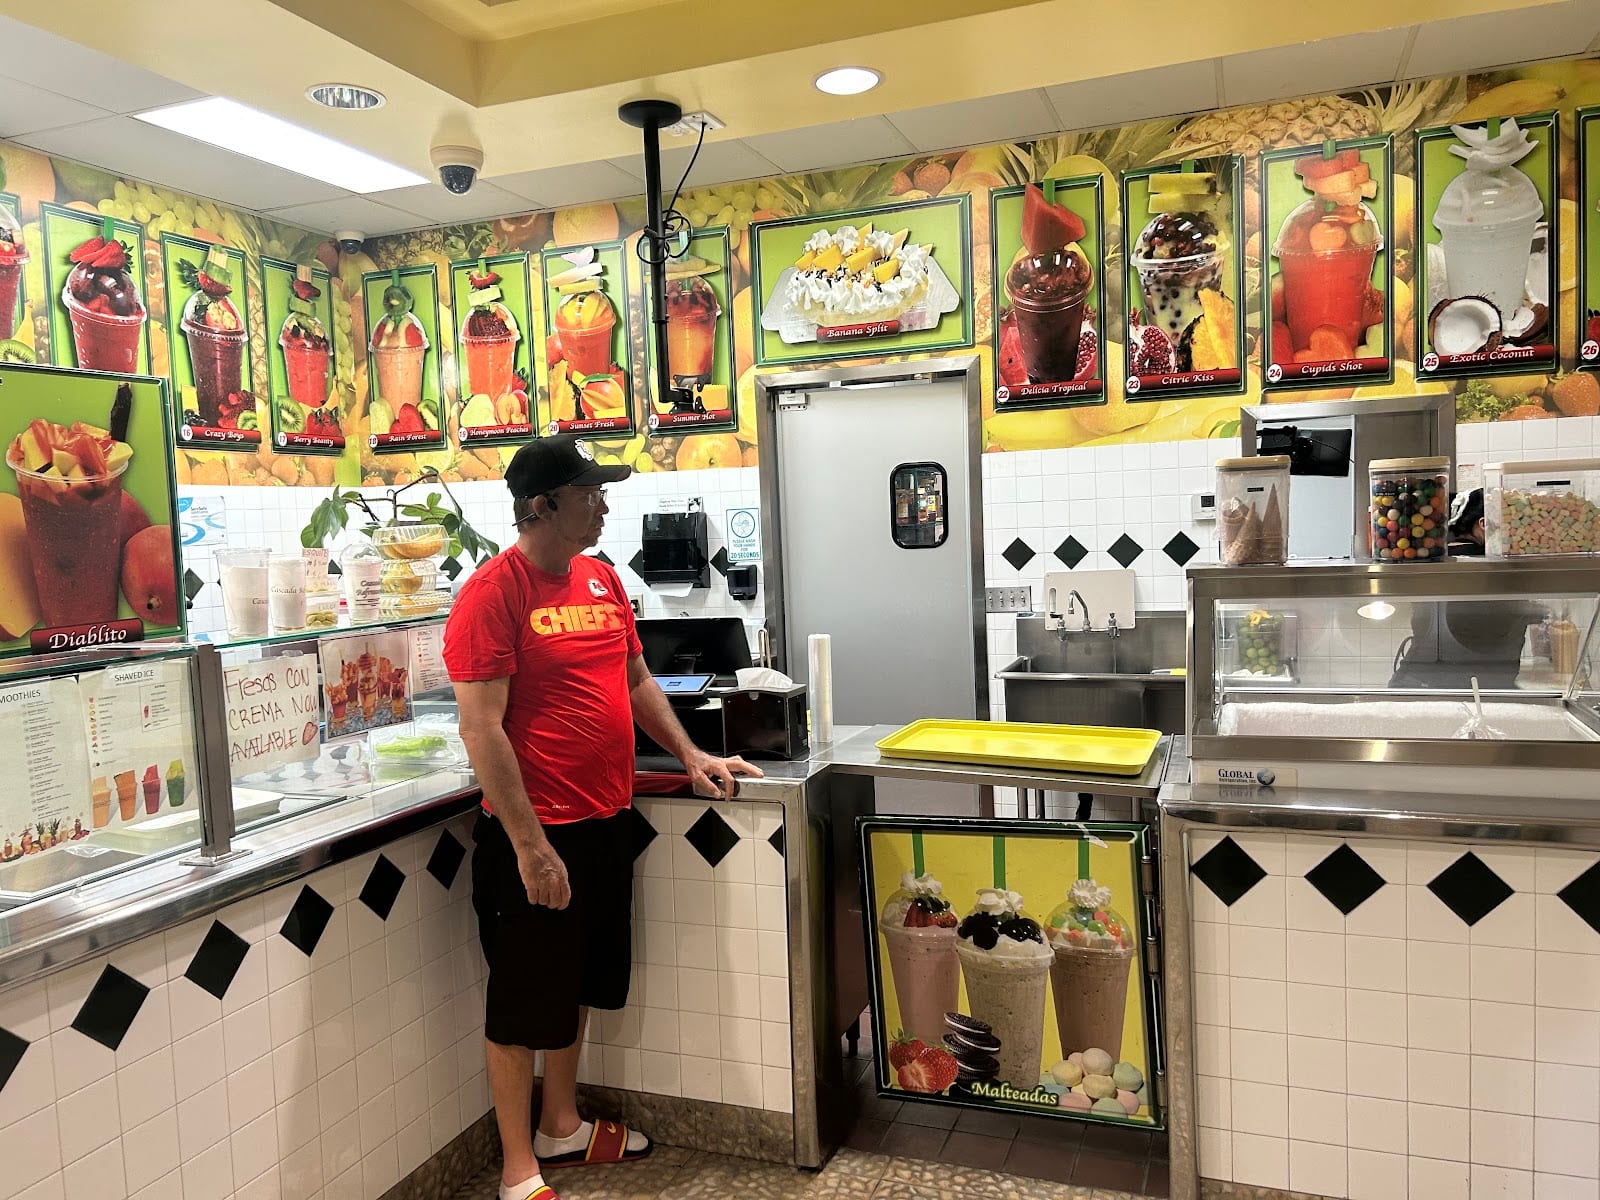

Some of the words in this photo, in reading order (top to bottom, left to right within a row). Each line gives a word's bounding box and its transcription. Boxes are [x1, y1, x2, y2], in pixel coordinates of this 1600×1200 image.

[827, 328, 862, 338] Banana
[866, 322, 888, 336] Split
[1450, 351, 1486, 362] Exotic
[1489, 348, 1534, 360] Coconut
[1583, 344, 1597, 356] 26
[1301, 362, 1336, 374] Cupids
[1340, 360, 1363, 372] Shot
[1424, 356, 1438, 367] 25
[1162, 374, 1190, 384] Citric
[1193, 373, 1215, 382] Kiss
[1269, 368, 1281, 378] 24
[1021, 386, 1050, 396] Delicia
[1052, 382, 1088, 394] Tropical
[1128, 380, 1138, 389] 23
[998, 390, 1008, 398] 22
[672, 414, 700, 422] Summer
[702, 413, 716, 421] Hot
[570, 422, 592, 430] Sunset
[594, 419, 615, 428] Fresh
[183, 428, 190, 437] 16
[204, 430, 226, 440] Crazy
[227, 430, 244, 442] Boys
[470, 428, 504, 438] Honeymoon
[506, 426, 529, 434] Peaches
[294, 436, 312, 446] Berry
[530, 604, 625, 636] CHIEFS
[50, 624, 127, 648] Diablito
[114, 672, 143, 681] SHAVED
[286, 667, 310, 688] CON
[228, 702, 284, 731] CREMA
[230, 728, 298, 763] AVAILABLE
[1218, 768, 1254, 779] GLOBAL
[971, 1081, 1057, 1105] Malteadas
